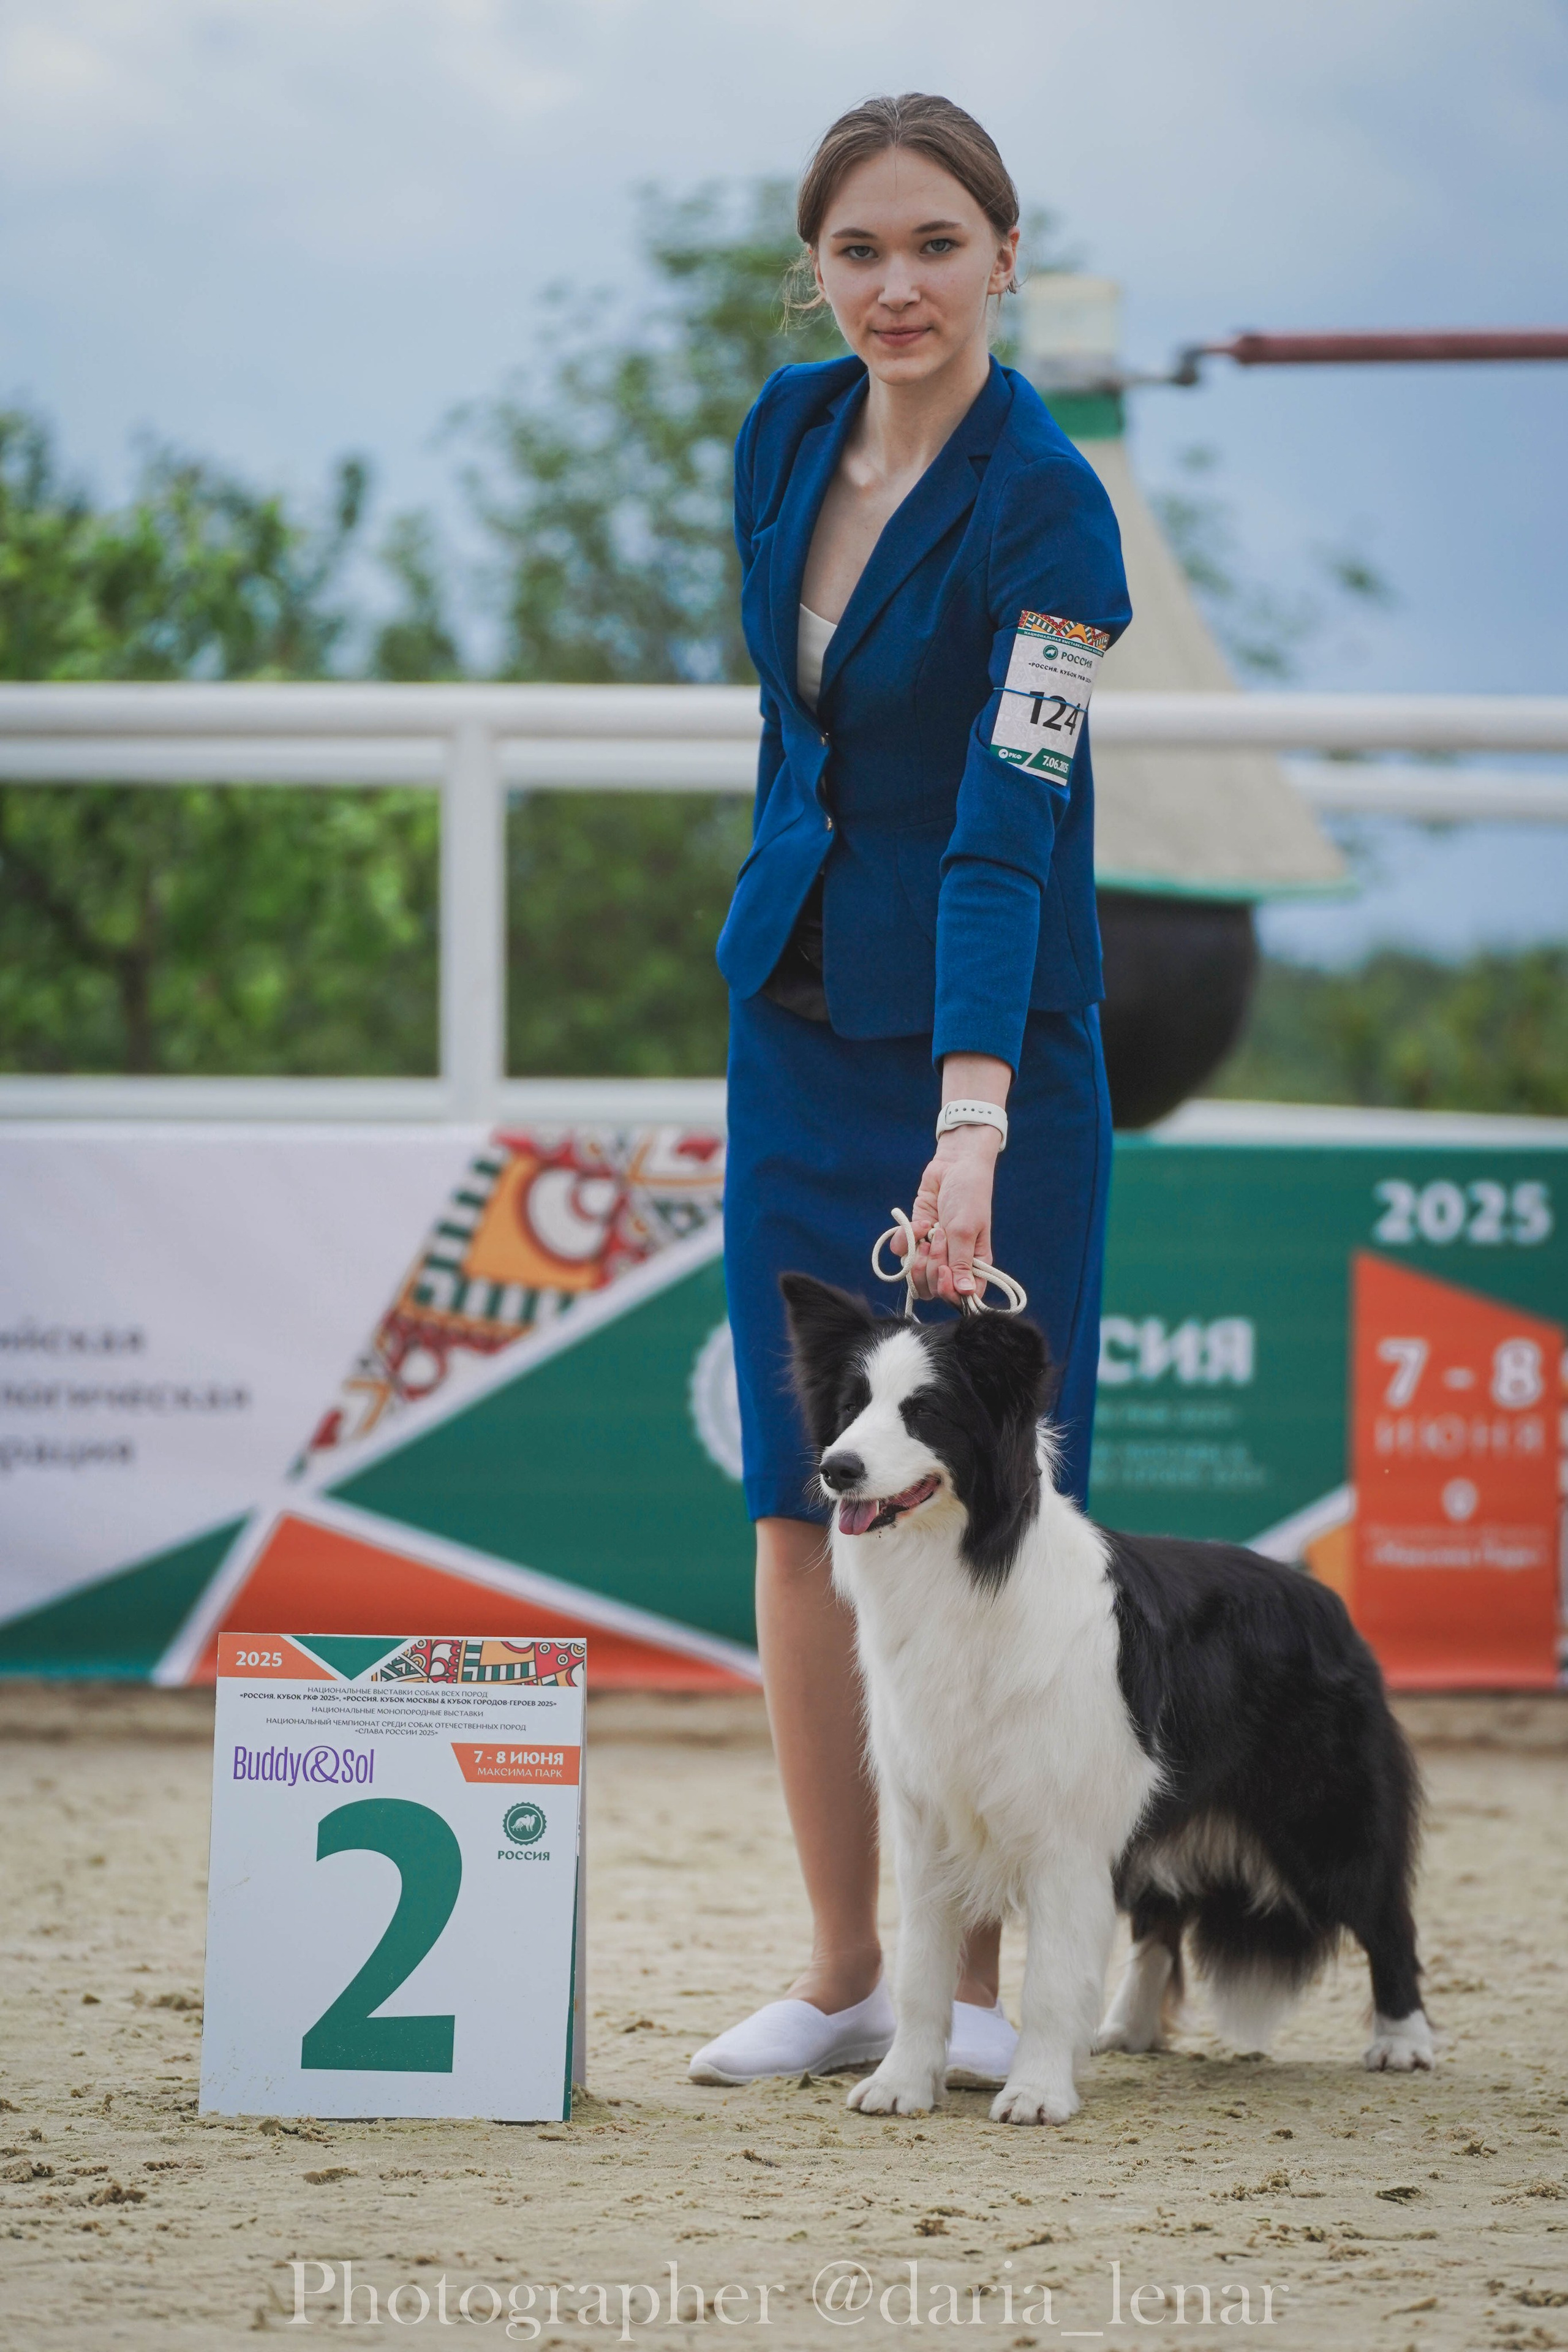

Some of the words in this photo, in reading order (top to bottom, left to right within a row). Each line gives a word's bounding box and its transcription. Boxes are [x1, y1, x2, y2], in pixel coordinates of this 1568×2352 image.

[1061, 652, 1093, 668] РОССИЯ
[1060, 669, 1077, 679] КУБОК
[1030, 690, 1081, 735] 124
[1042, 755, 1069, 773] 7.06.2025
[1374, 1180, 1554, 1245] 2025
[1377, 1338, 1430, 1408] 7
[1491, 1337, 1544, 1409] 8
[236, 1651, 282, 1667] 2025
[307, 1687, 371, 1695] НАЦИОНАЛЬНЫЕ
[266, 1717, 331, 1726] НАЦИОНАЛЬНЫЙ
[473, 1751, 483, 1763] 7
[496, 1751, 506, 1764] 8
[510, 1752, 564, 1765] ИЮНЯ
[477, 1767, 533, 1777] МАКСИМА
[535, 1769, 562, 1778] ПАРК
[497, 1849, 550, 1861] РОССИЯ
[301, 1798, 462, 2073] 2
